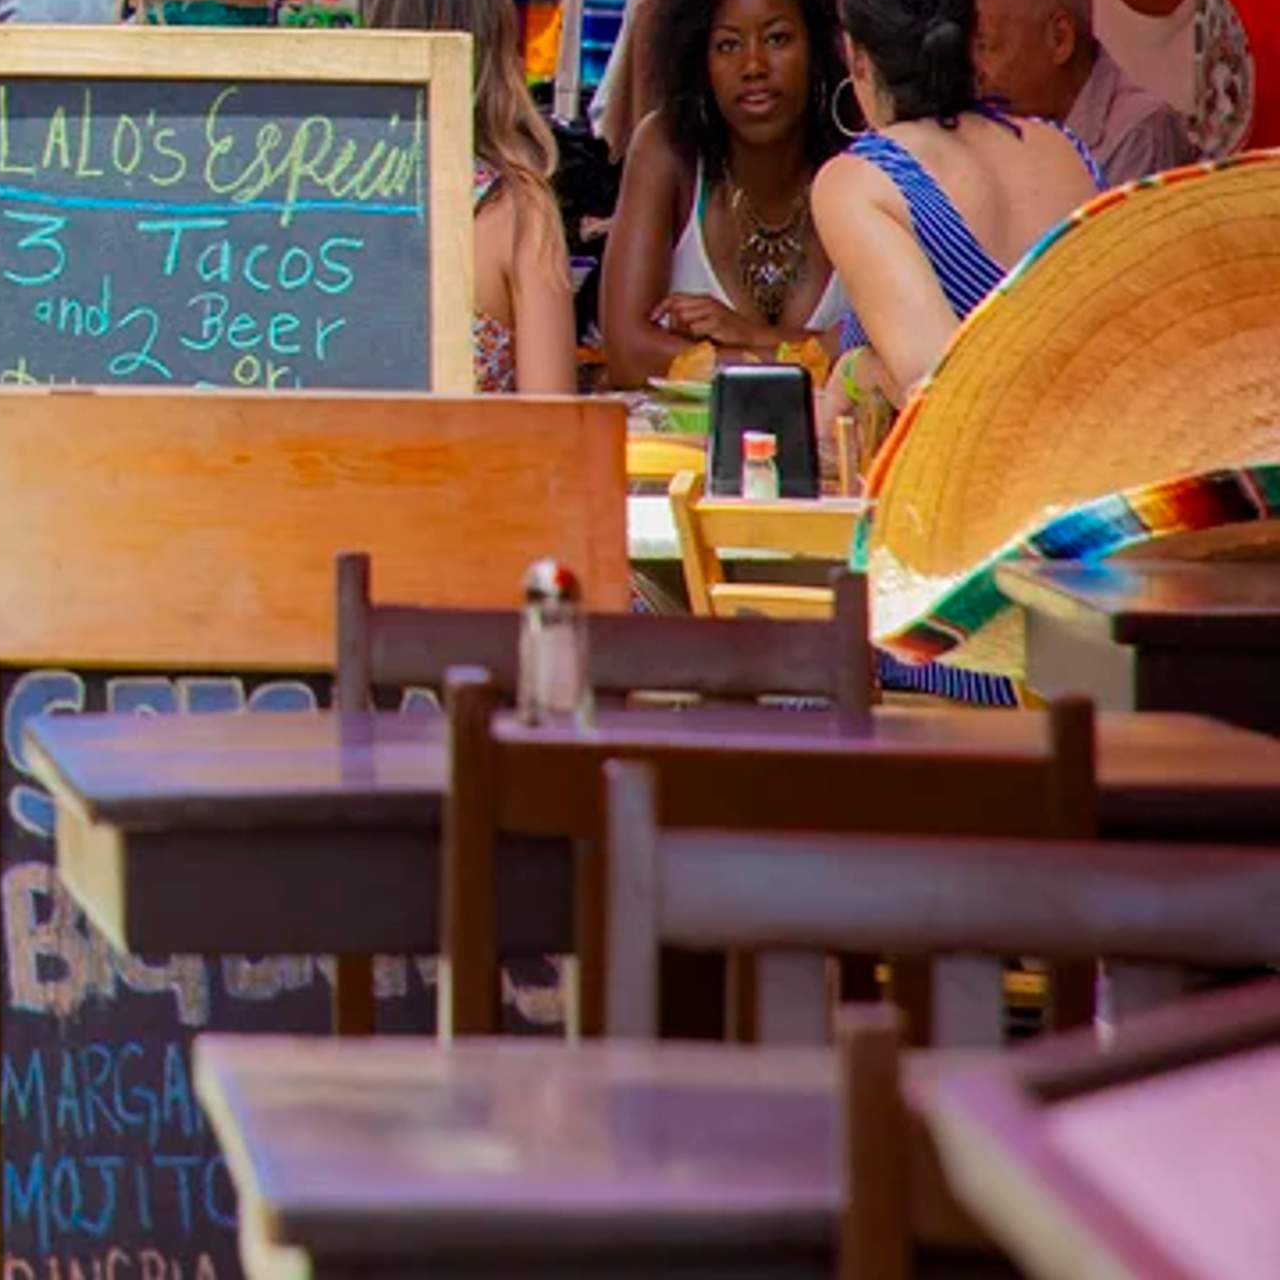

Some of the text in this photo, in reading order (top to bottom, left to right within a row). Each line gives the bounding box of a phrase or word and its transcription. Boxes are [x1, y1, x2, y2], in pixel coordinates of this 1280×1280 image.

[3, 209, 364, 294] 3 Tacos
[36, 274, 110, 336] and
[109, 307, 173, 379] 2
[179, 291, 346, 361] Beer
[234, 354, 289, 392] or
[0, 1042, 204, 1150] MARGA
